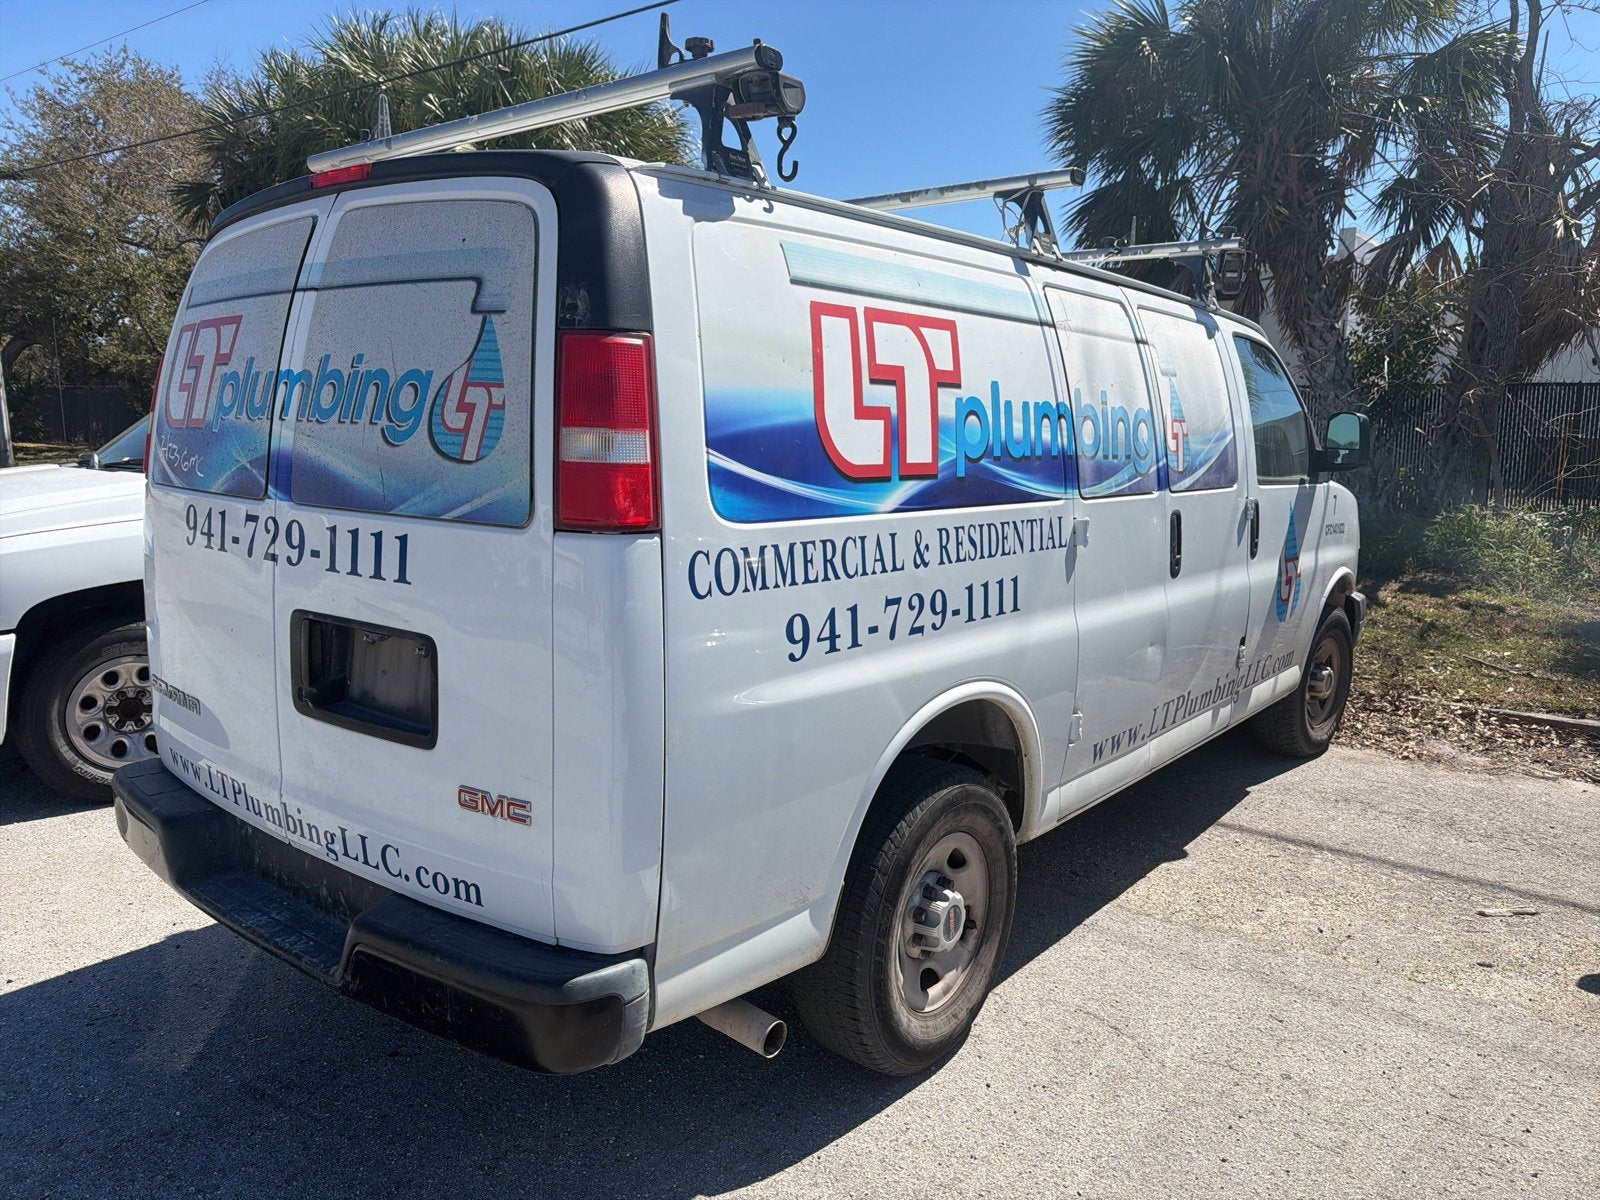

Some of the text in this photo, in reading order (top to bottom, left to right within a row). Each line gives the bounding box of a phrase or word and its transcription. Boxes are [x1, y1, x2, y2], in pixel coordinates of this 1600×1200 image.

[164, 314, 434, 447] LT plumbing
[810, 300, 1153, 484] LT plumbing
[184, 503, 412, 586] 941-729-1111
[687, 515, 1068, 601] COMMERCIAL & RESIDENTIAL
[785, 575, 1022, 663] 941-729-1111
[1091, 650, 1295, 764] www.LTPlumbingLLC.com
[169, 748, 485, 907] www.LTPlumbingLLC.com
[457, 784, 533, 826] GMC
